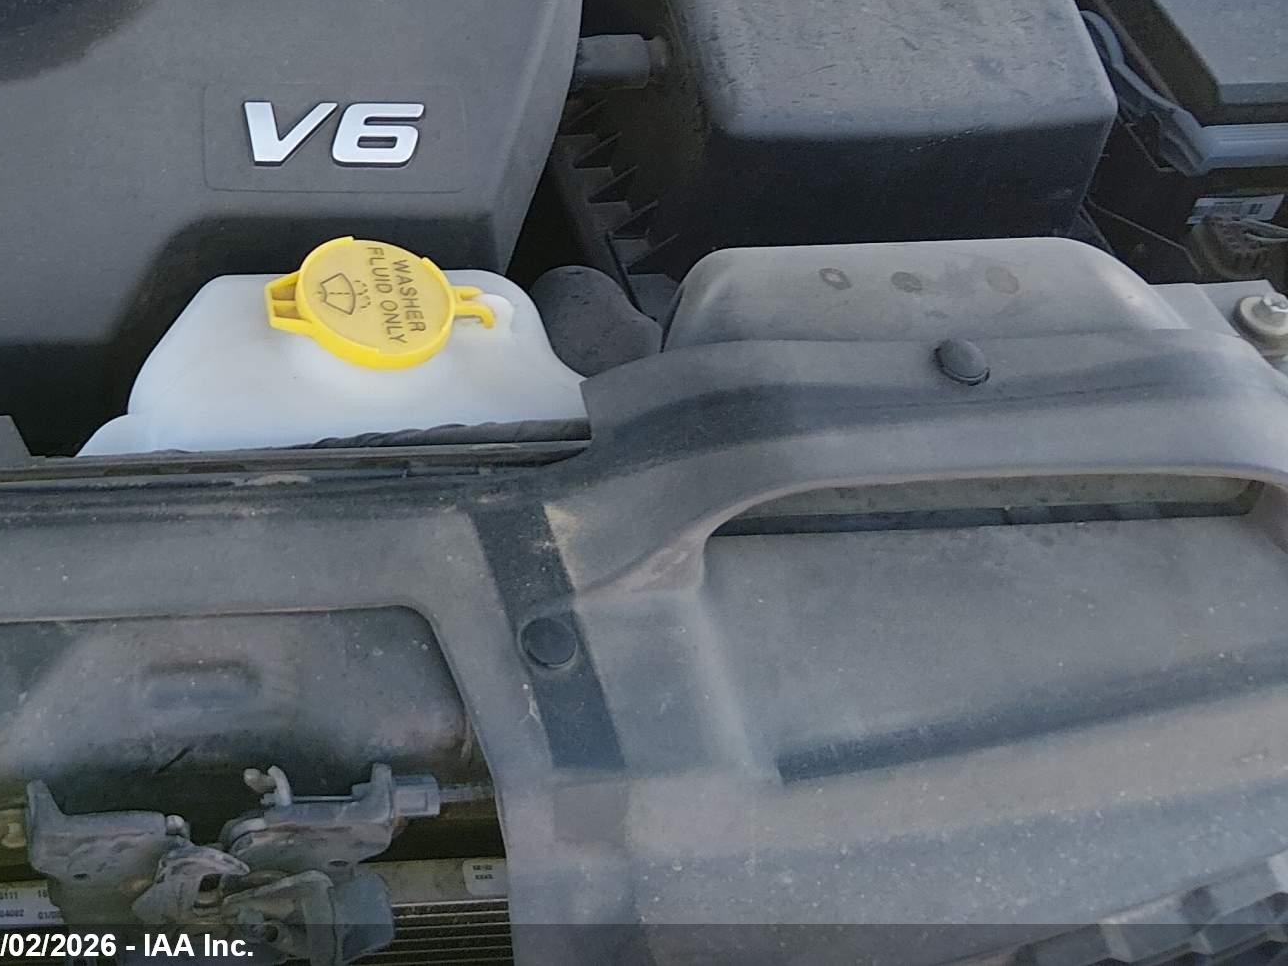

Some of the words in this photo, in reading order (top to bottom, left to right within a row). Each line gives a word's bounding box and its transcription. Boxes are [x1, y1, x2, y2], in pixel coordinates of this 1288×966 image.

[243, 101, 425, 167] V6
[366, 247, 393, 294] FLUID
[392, 259, 427, 332] WASHER
[379, 299, 409, 344] ONLY
